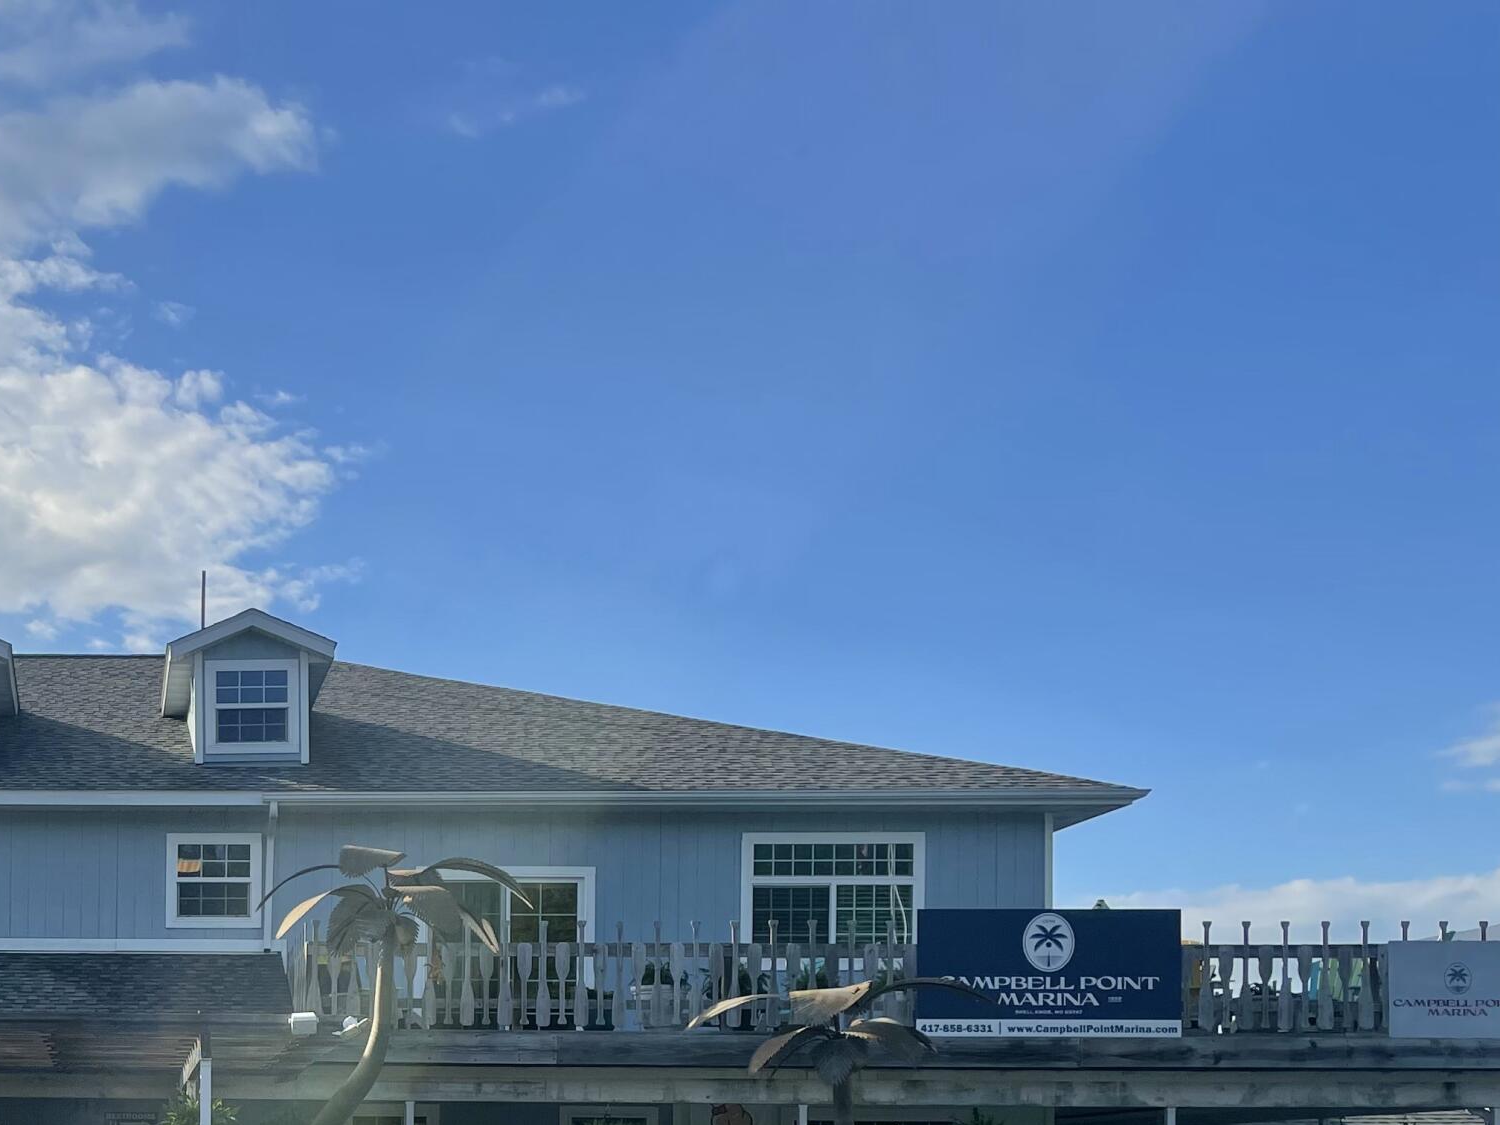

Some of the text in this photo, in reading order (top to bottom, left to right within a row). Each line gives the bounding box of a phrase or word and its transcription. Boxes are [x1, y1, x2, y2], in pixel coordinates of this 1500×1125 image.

[940, 975, 1161, 990] AMPBELL POINT
[997, 992, 1100, 1006] MARINA
[1393, 998, 1472, 1008] CAMPBELL
[1427, 1008, 1488, 1017] MARINA
[920, 1024, 993, 1034] 417-858-6331
[1007, 1024, 1178, 1035] www.CampbellPointMarina.com
